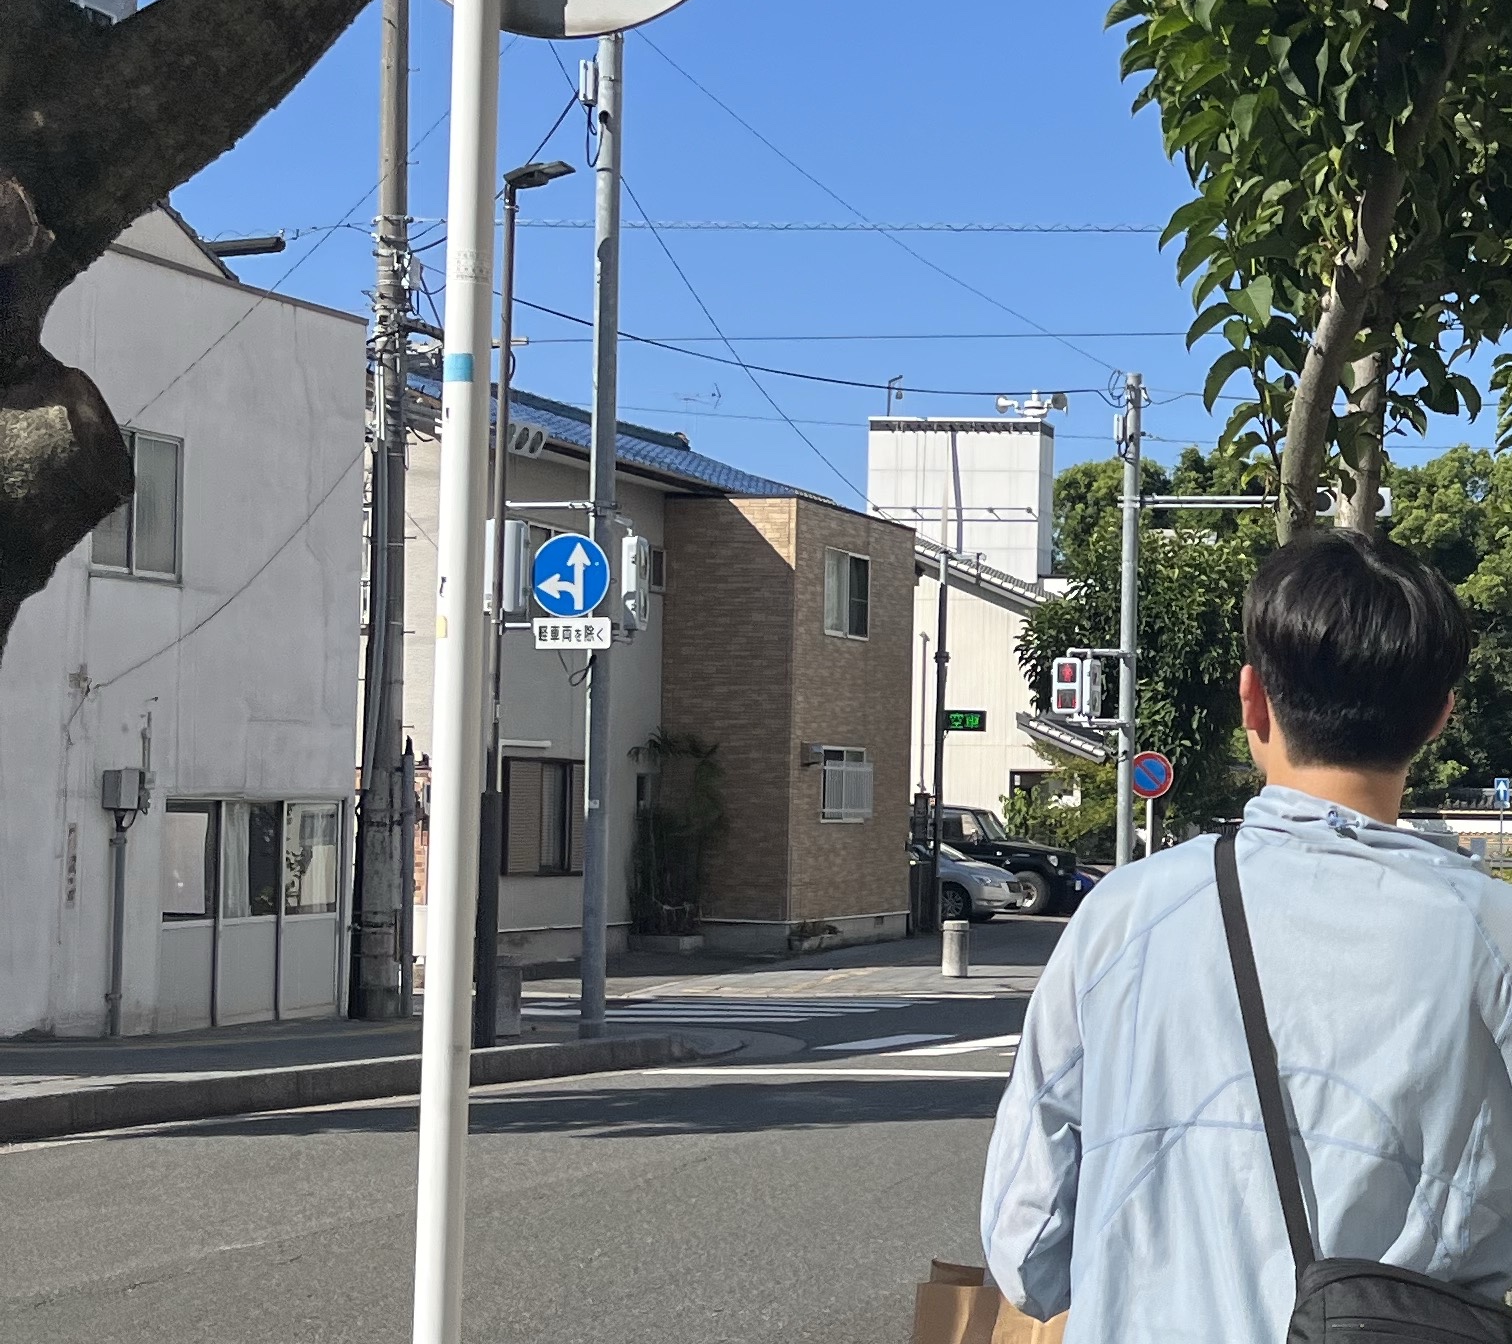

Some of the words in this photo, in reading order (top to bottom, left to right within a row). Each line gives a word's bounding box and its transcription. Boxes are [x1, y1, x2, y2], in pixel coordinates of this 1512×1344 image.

[538, 624, 604, 643] 軽車両を除く
